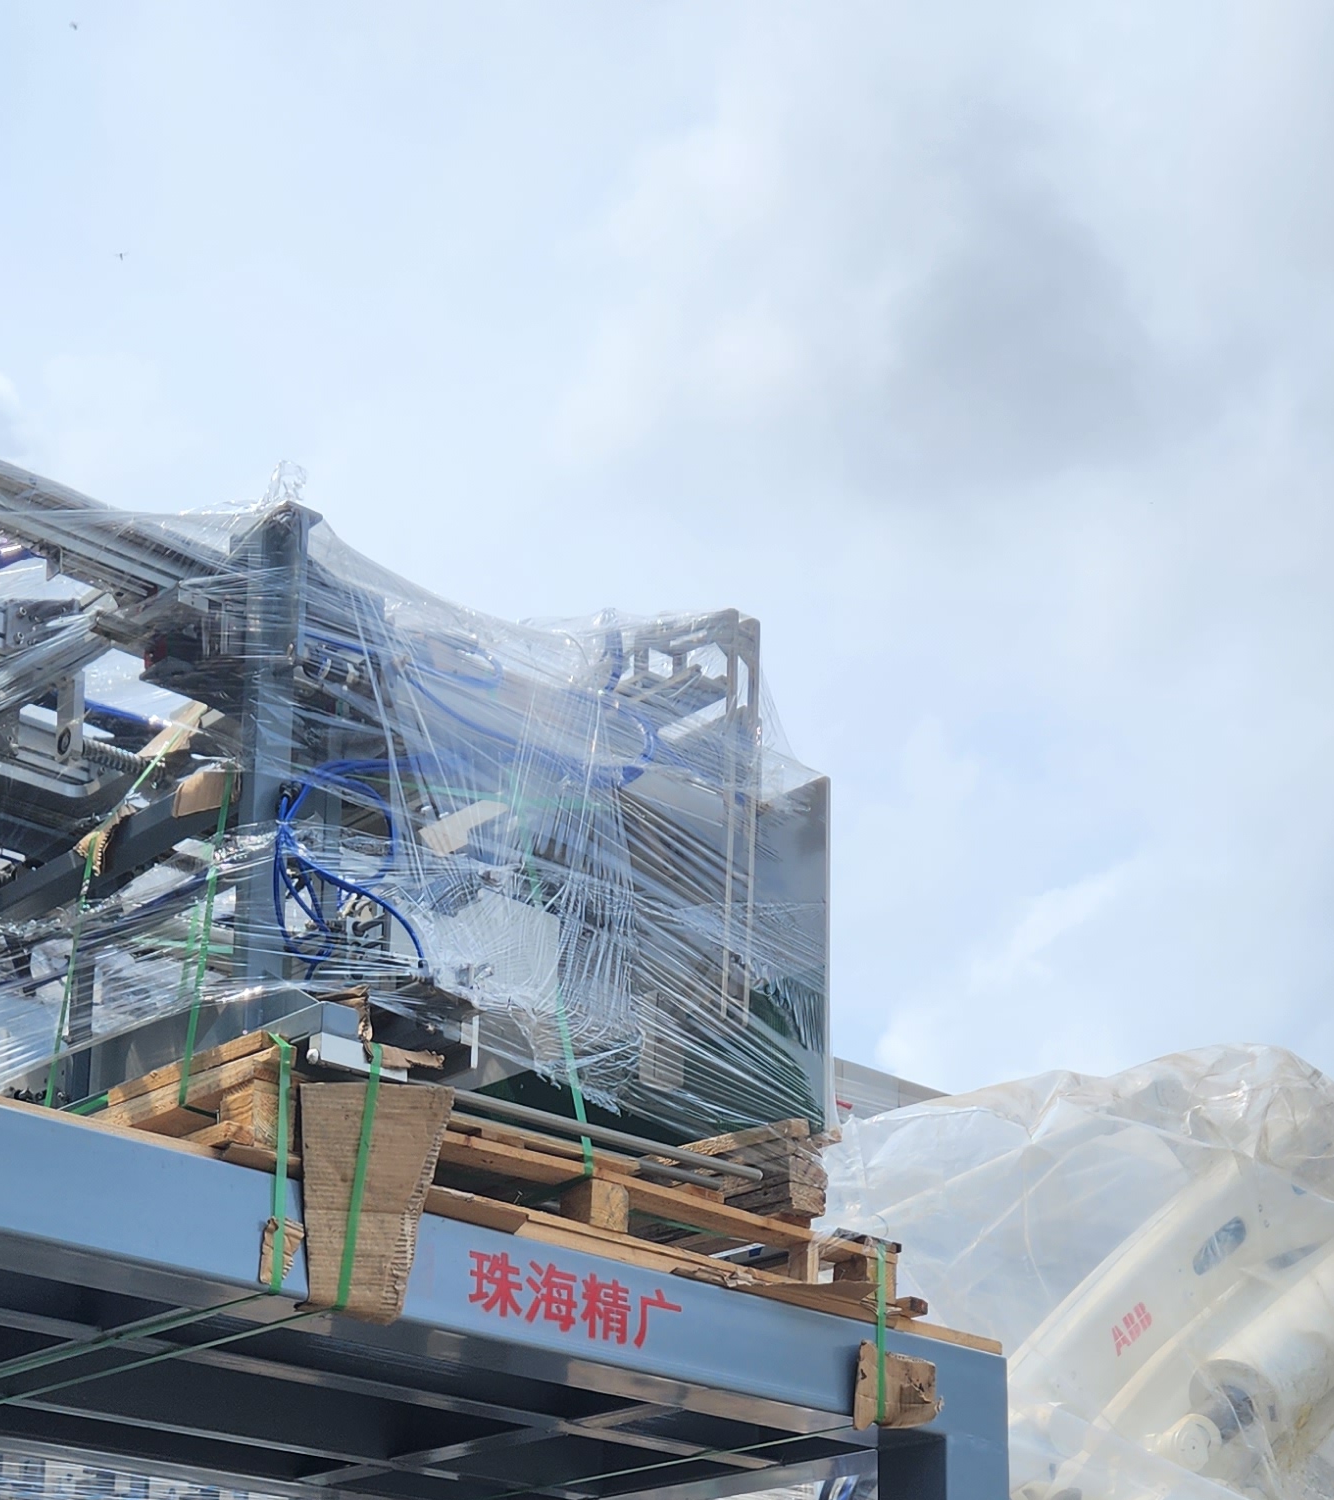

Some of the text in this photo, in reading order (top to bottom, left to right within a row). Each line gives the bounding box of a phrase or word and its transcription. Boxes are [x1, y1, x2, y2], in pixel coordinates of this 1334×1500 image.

[468, 1250, 683, 1350] 珠海精广
[1111, 1301, 1153, 1357] ABB
